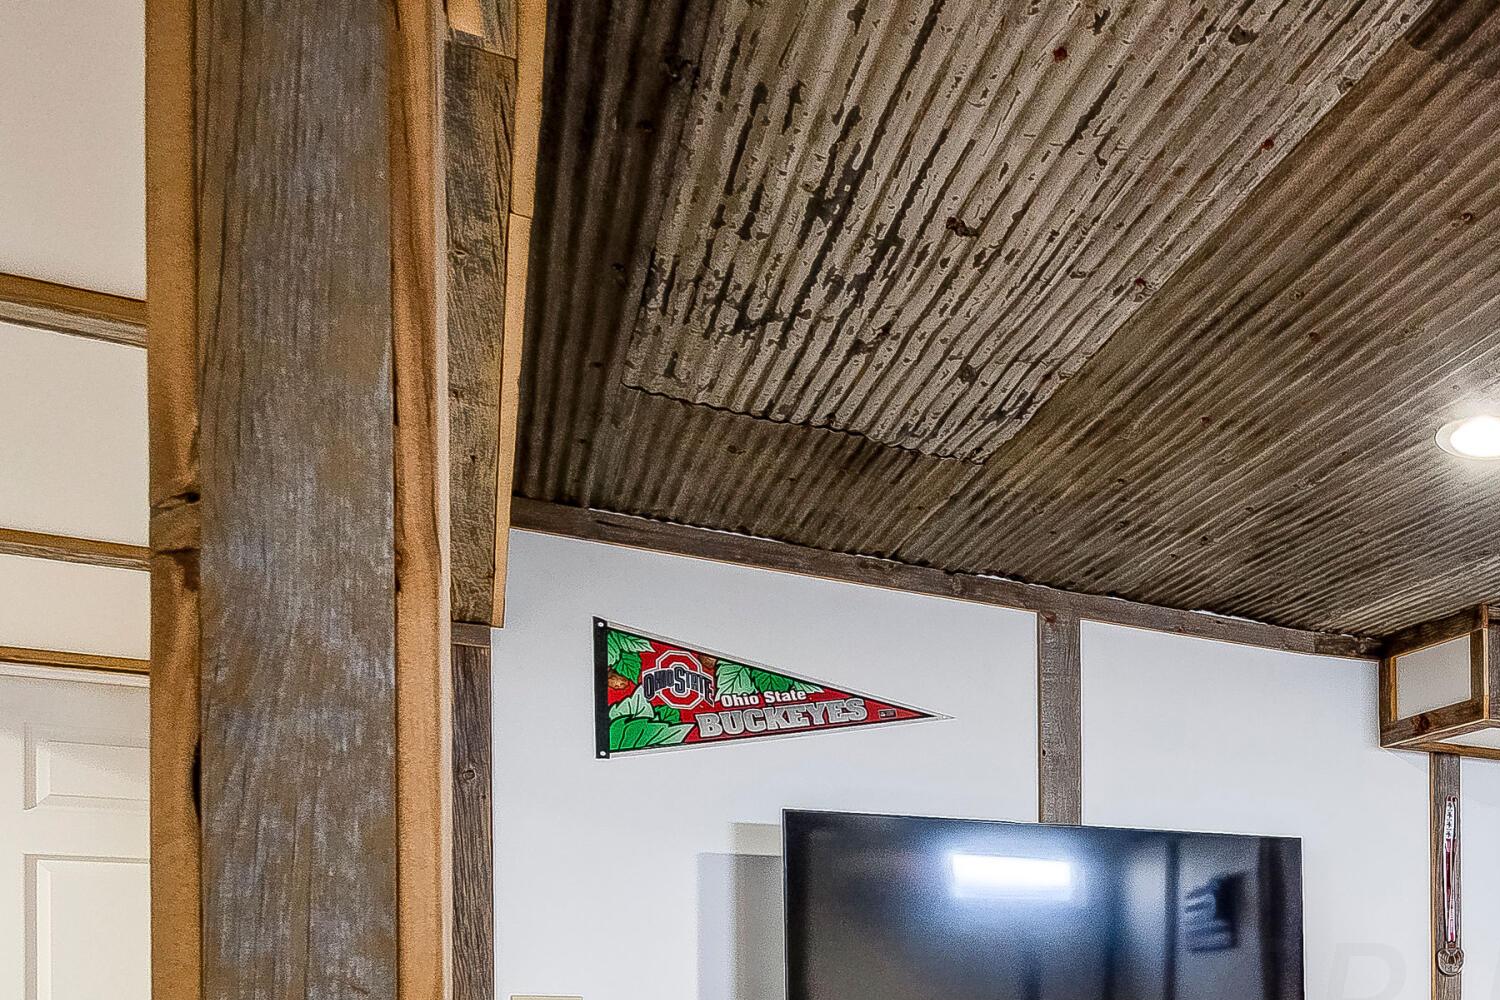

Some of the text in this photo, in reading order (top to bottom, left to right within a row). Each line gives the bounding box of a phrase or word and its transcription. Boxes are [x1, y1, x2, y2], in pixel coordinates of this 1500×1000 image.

[720, 688, 807, 708] Ohio State
[695, 698, 868, 738] BUCKEYES
